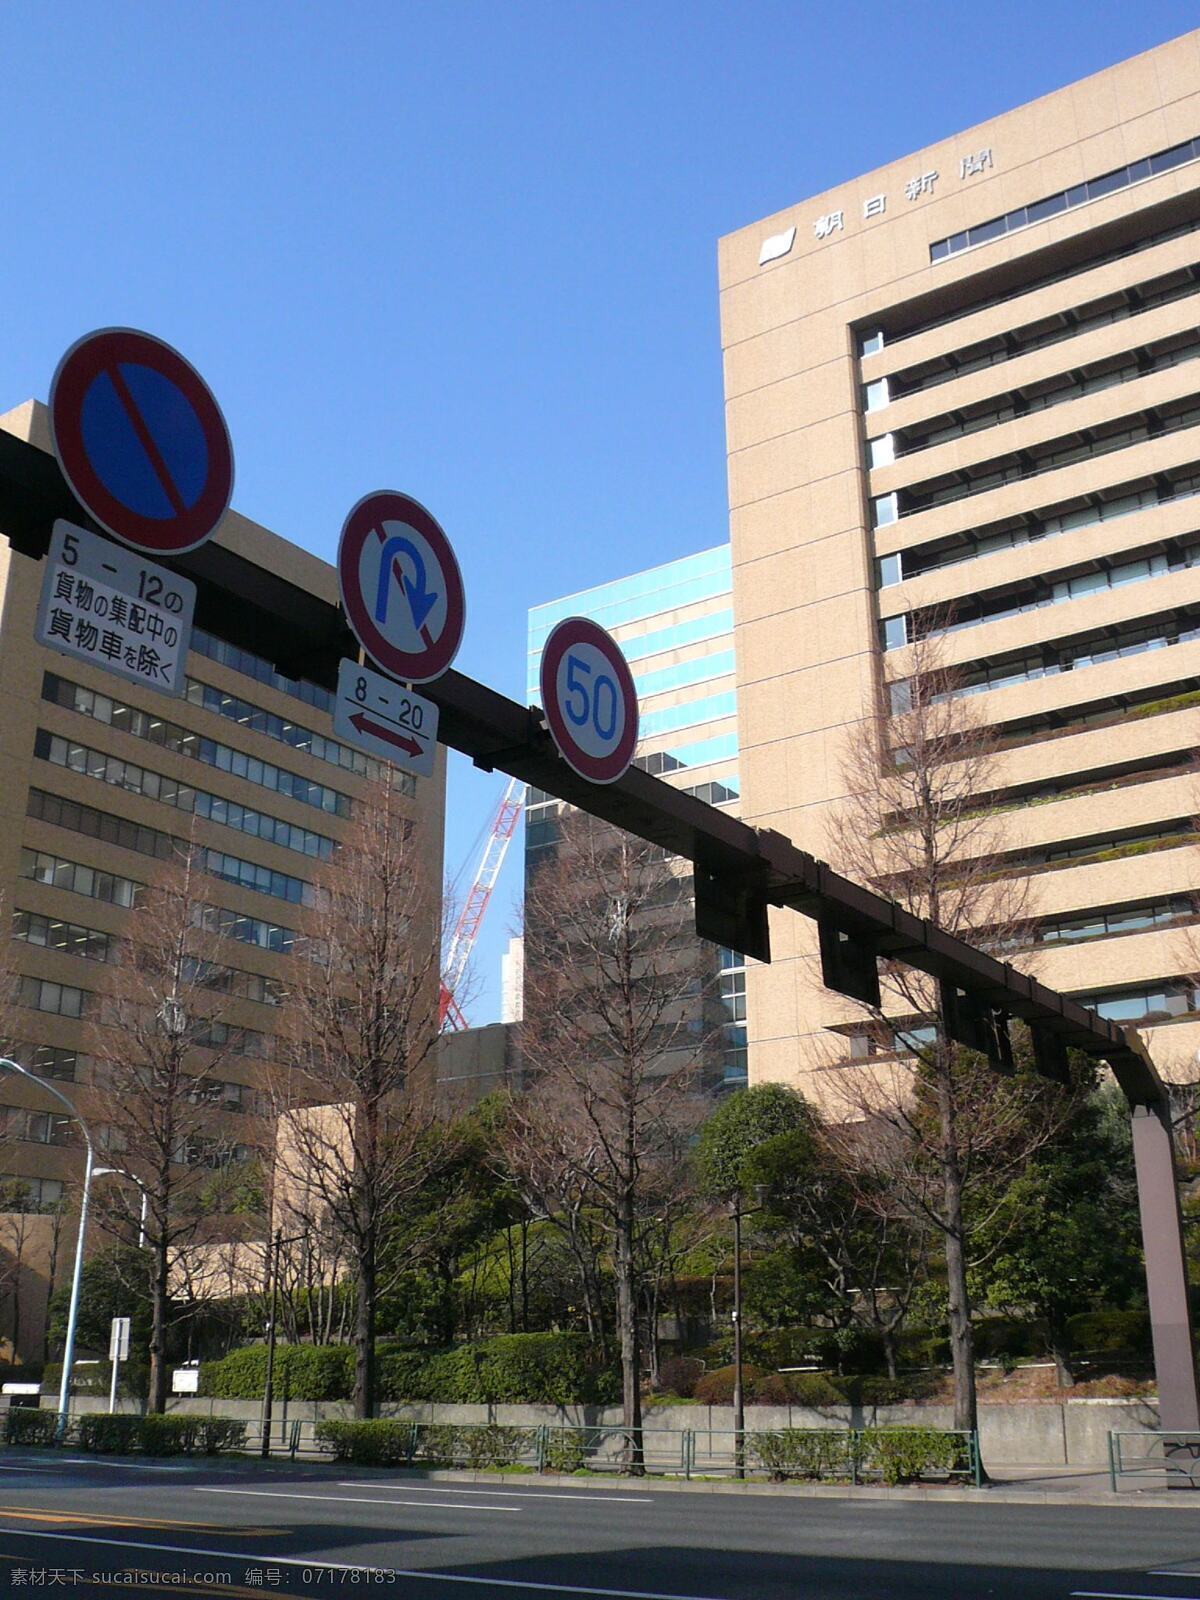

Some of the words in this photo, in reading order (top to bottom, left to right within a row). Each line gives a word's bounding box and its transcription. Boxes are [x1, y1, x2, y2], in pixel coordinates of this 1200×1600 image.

[813, 148, 994, 239] 朝日新聞
[47, 607, 173, 683] 貨物車を除く
[53, 571, 178, 648] 貨物の集配中の
[565, 654, 617, 741] 50
